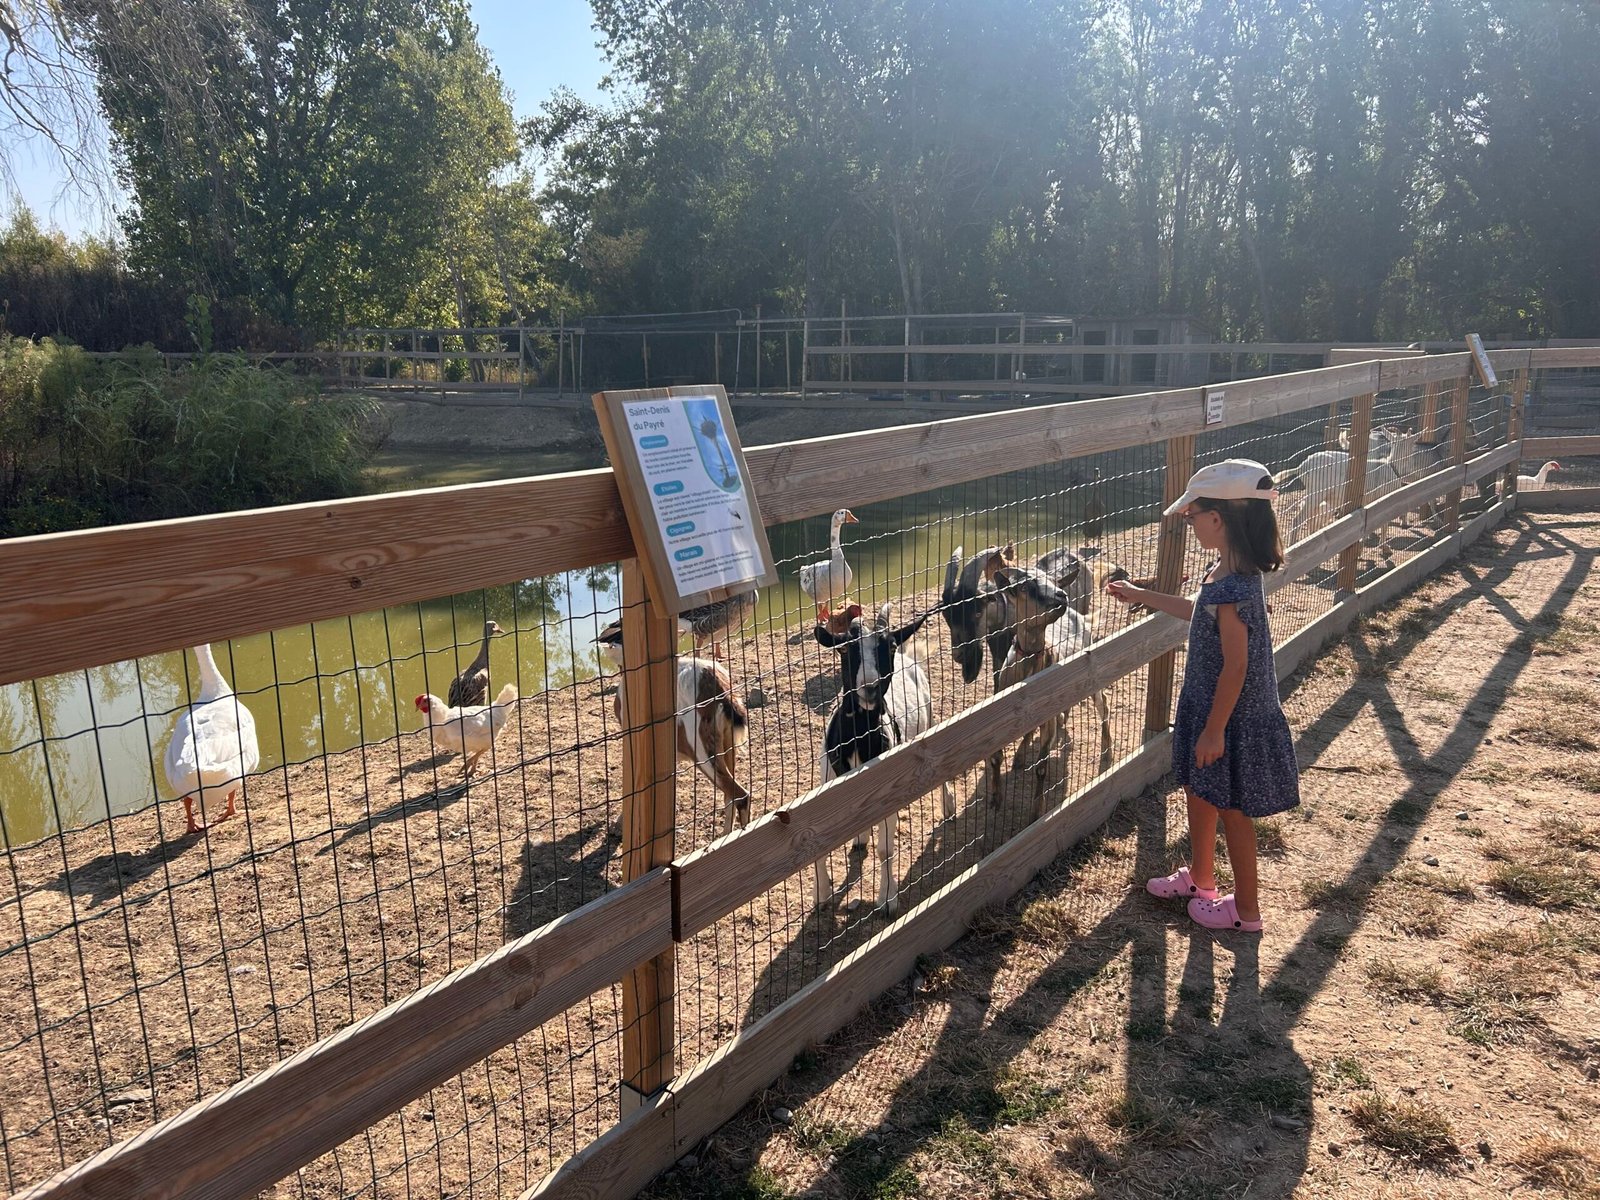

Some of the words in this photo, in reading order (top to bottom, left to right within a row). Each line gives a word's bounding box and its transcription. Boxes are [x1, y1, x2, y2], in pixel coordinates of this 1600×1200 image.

[629, 406, 671, 416] Saint-Denis
[633, 421, 643, 431] du
[644, 419, 665, 431] Payré
